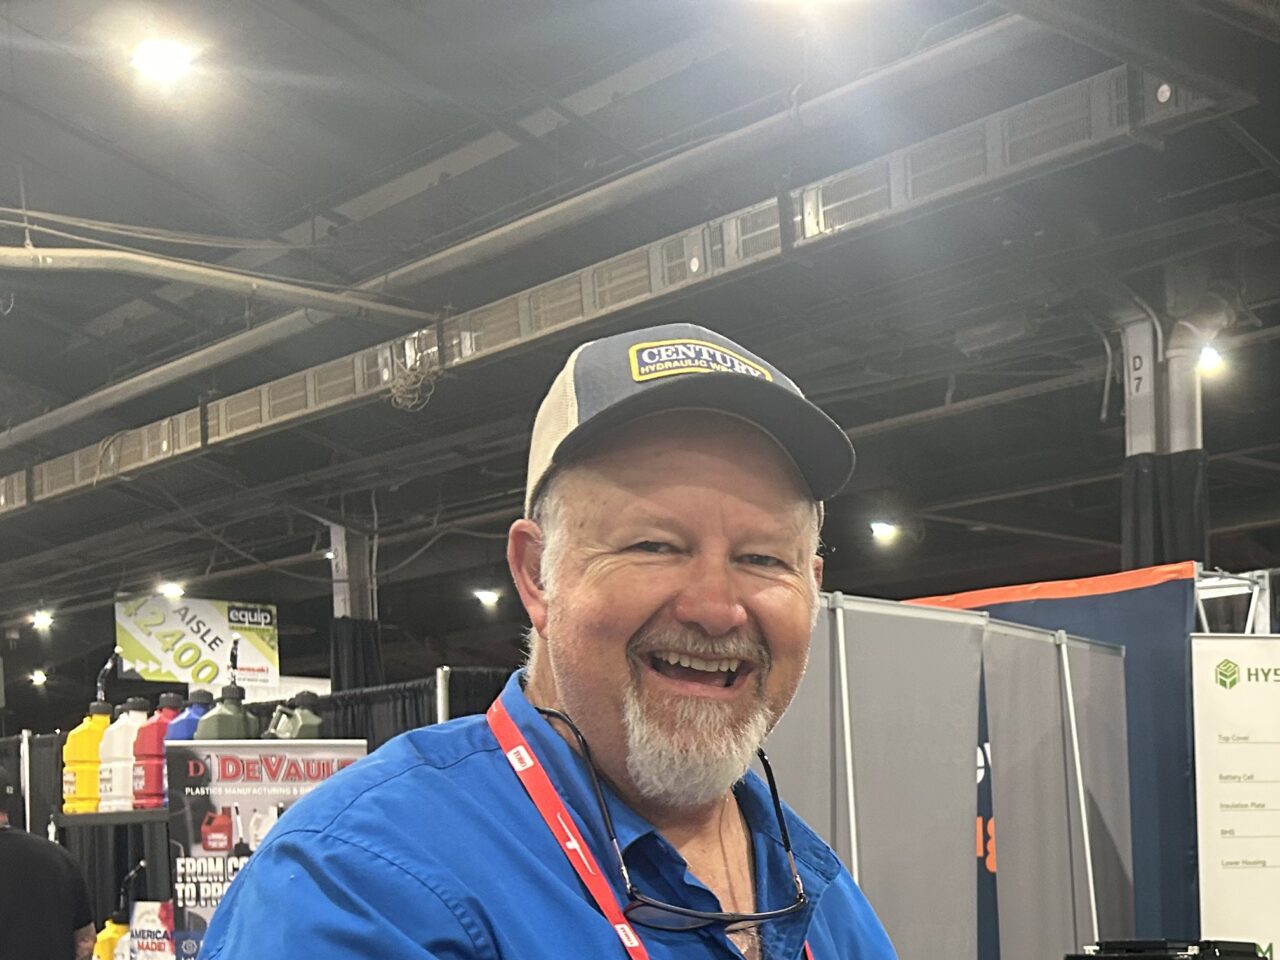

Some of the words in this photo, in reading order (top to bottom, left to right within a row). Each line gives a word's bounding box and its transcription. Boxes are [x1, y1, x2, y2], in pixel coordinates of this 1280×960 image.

[640, 359, 708, 374] HYDRAULIC
[641, 343, 761, 377] CENTURY
[1132, 355, 1143, 372] D
[1133, 376, 1143, 393] 7
[229, 608, 271, 627] equip
[173, 605, 224, 651] AISLE
[185, 787, 222, 796] PLASTICS
[224, 787, 292, 796] MANUFACTURING
[176, 857, 224, 882] FROM
[175, 883, 197, 907] TO
